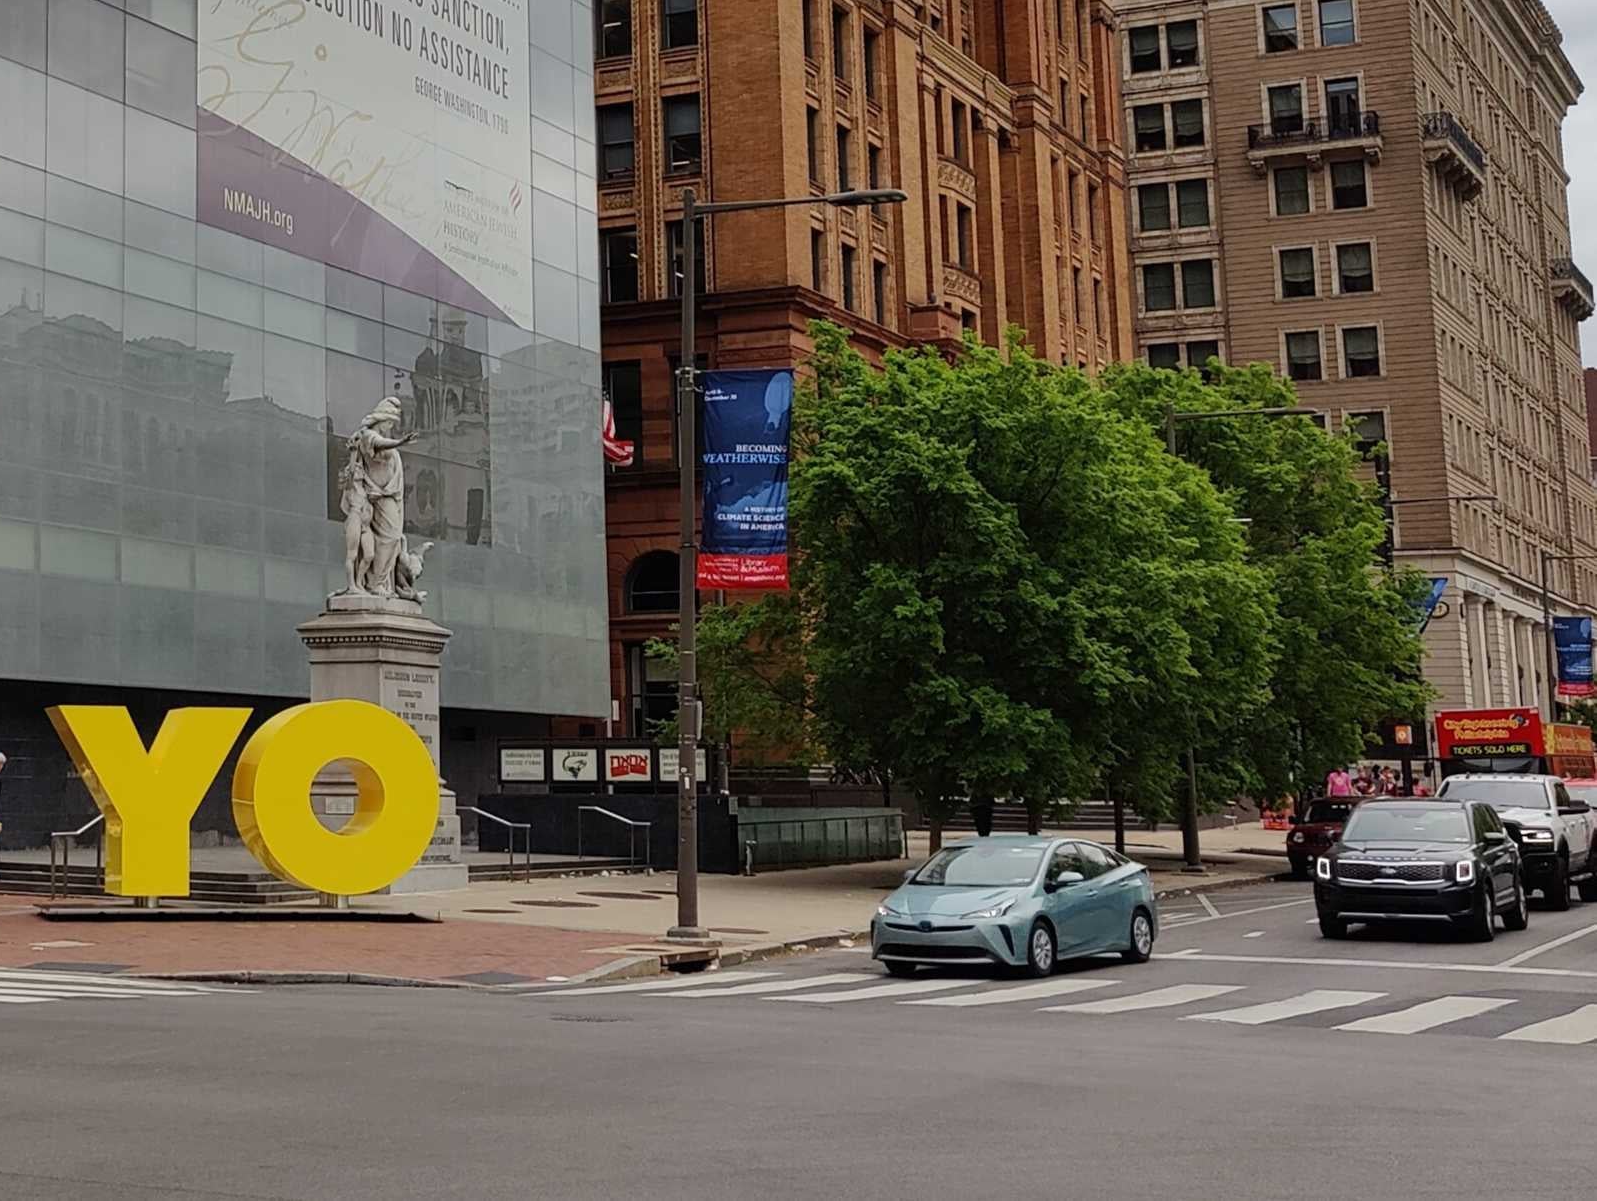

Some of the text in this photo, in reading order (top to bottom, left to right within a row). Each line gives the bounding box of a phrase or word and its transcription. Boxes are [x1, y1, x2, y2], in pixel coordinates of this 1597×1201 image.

[392, 10, 412, 52] NO
[419, 26, 508, 100] ASSISTANCE
[415, 76, 442, 104] GEORGE
[224, 187, 293, 235] NMAJH.org
[717, 513, 785, 522] CLIMATE SCIENCE
[751, 523, 785, 531] AMERICA
[1453, 744, 1527, 755] TICKETS SOLD HERE
[45, 699, 440, 896] YO
